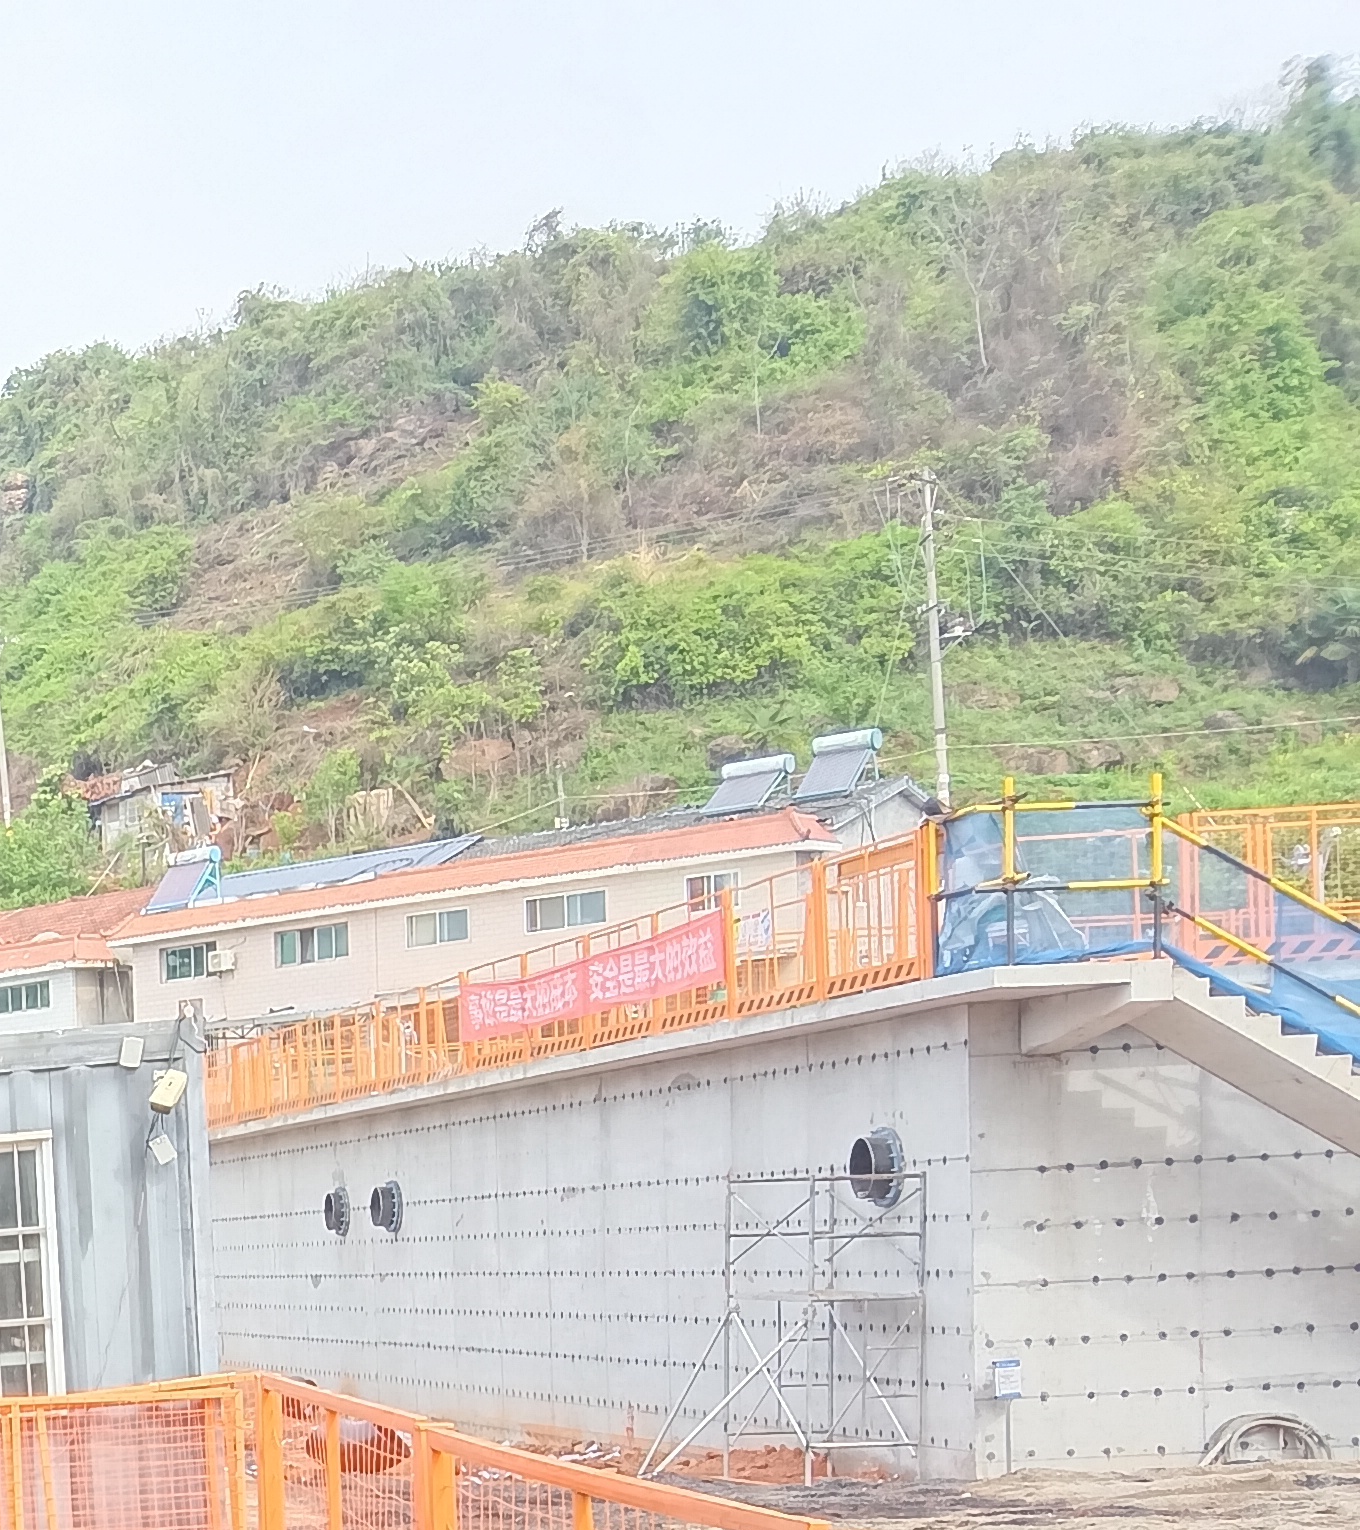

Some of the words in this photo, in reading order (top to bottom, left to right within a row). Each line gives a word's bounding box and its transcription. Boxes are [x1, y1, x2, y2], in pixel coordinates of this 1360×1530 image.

[588, 926, 717, 1002] 安全是最大的效益
